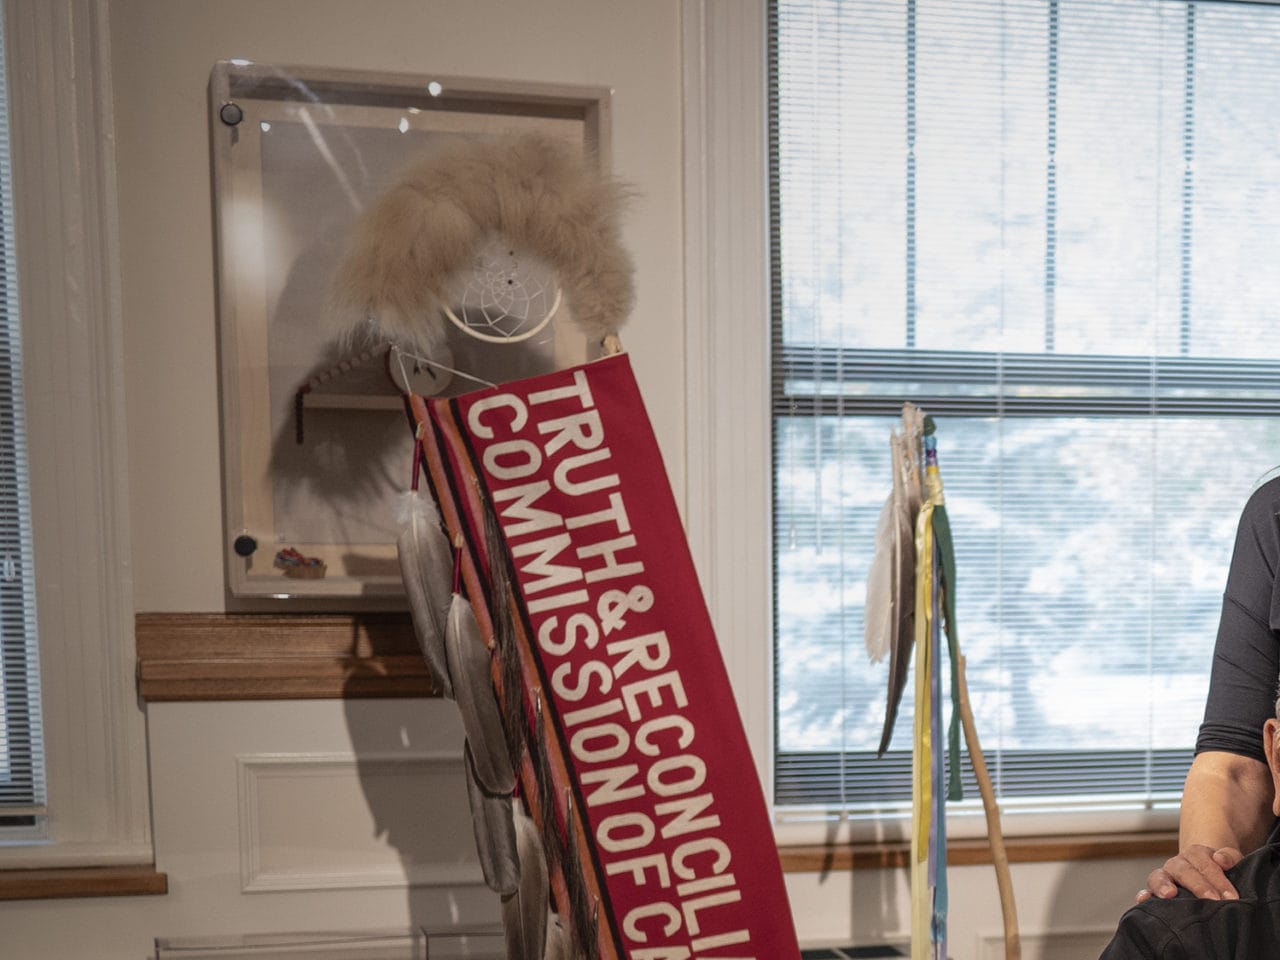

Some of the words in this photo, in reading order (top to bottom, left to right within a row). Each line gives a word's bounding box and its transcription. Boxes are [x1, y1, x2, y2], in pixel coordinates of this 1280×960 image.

[468, 394, 645, 807] COMMISSION
[597, 813, 670, 888] OF
[528, 370, 644, 583] TRUTH
[597, 585, 654, 636] &
